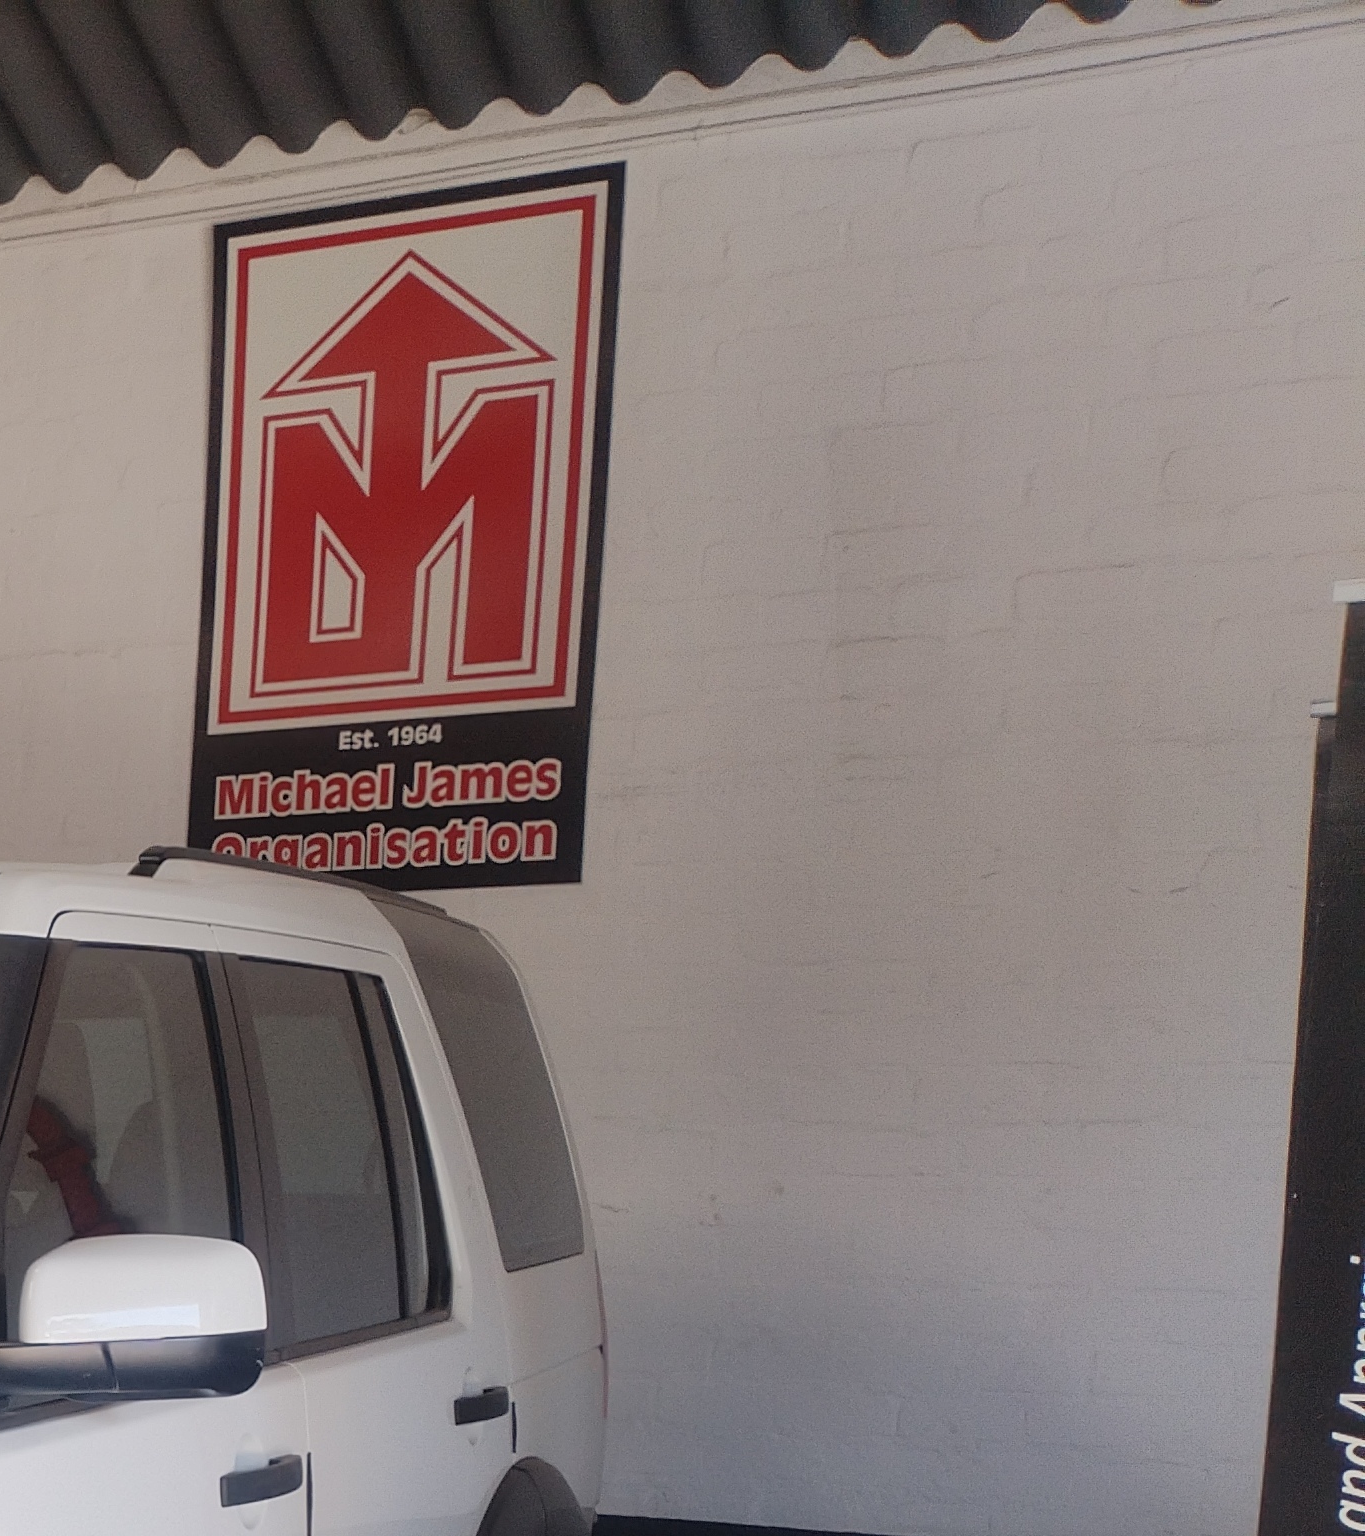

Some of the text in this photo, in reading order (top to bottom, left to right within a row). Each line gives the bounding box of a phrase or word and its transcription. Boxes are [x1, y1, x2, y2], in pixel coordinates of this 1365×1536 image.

[338, 723, 443, 750] Est. 1964
[214, 758, 562, 821] Michael James
